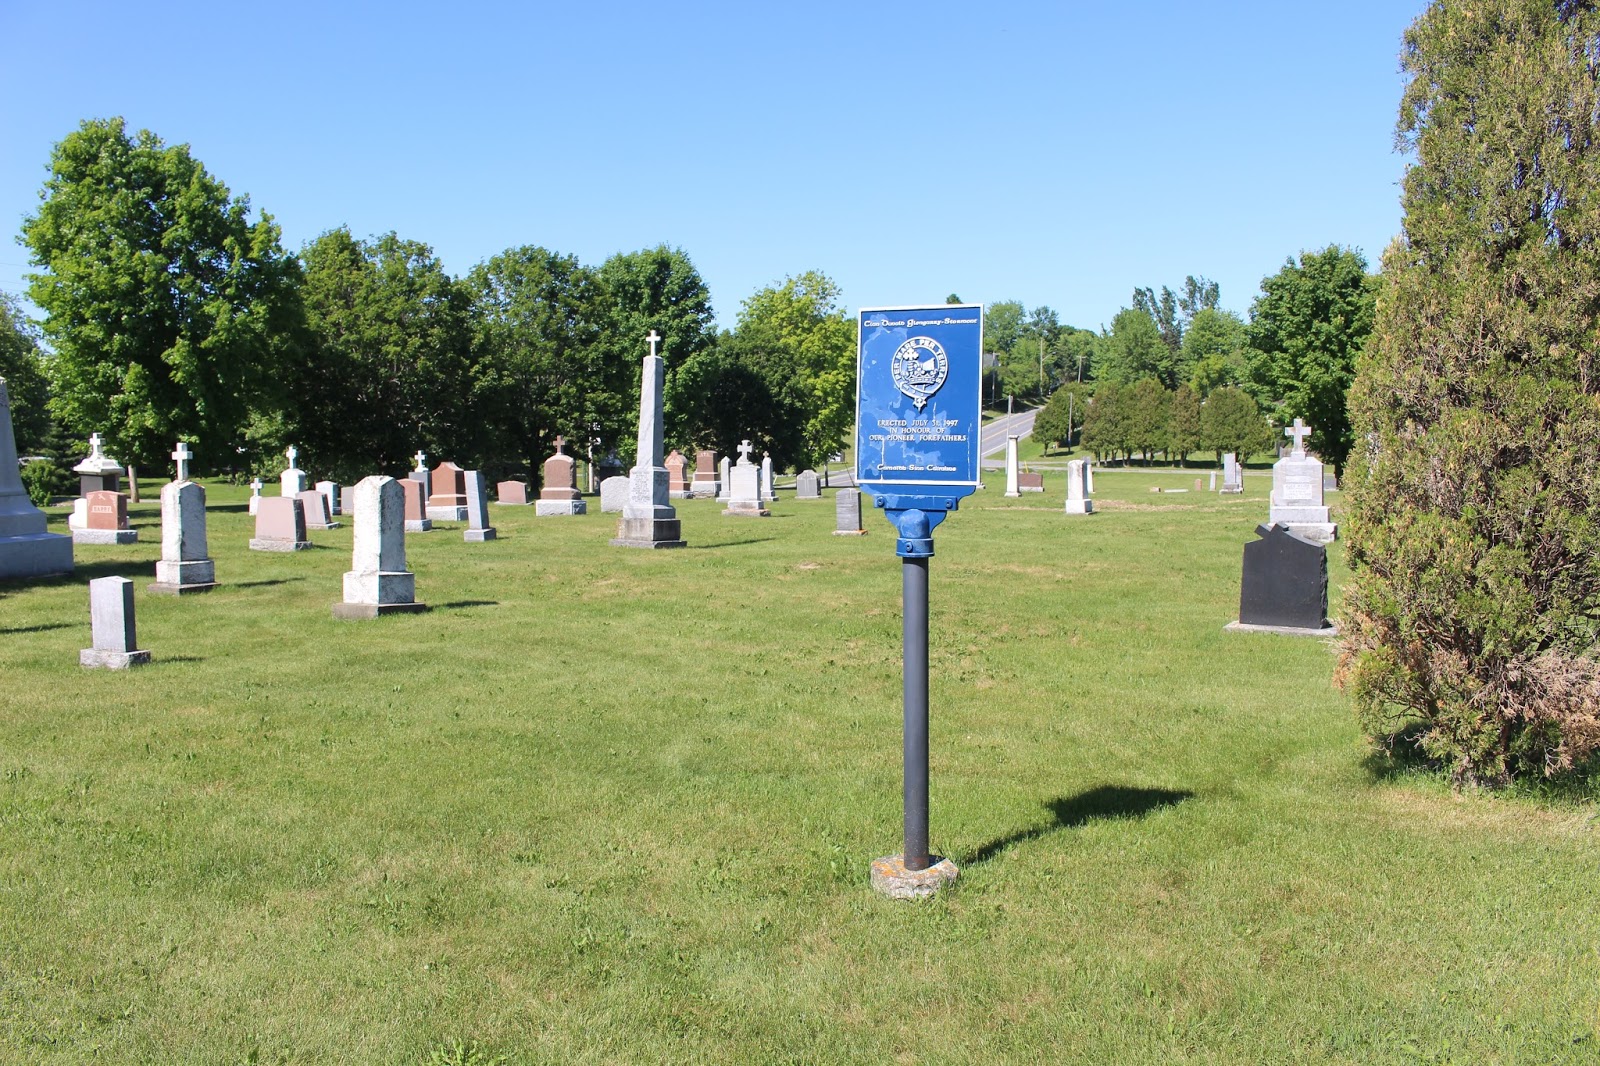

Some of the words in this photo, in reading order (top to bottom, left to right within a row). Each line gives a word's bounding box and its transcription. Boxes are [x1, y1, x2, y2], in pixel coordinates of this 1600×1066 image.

[894, 362, 902, 381] PER
[877, 419, 907, 427] ERECTED
[911, 419, 929, 427] JULY
